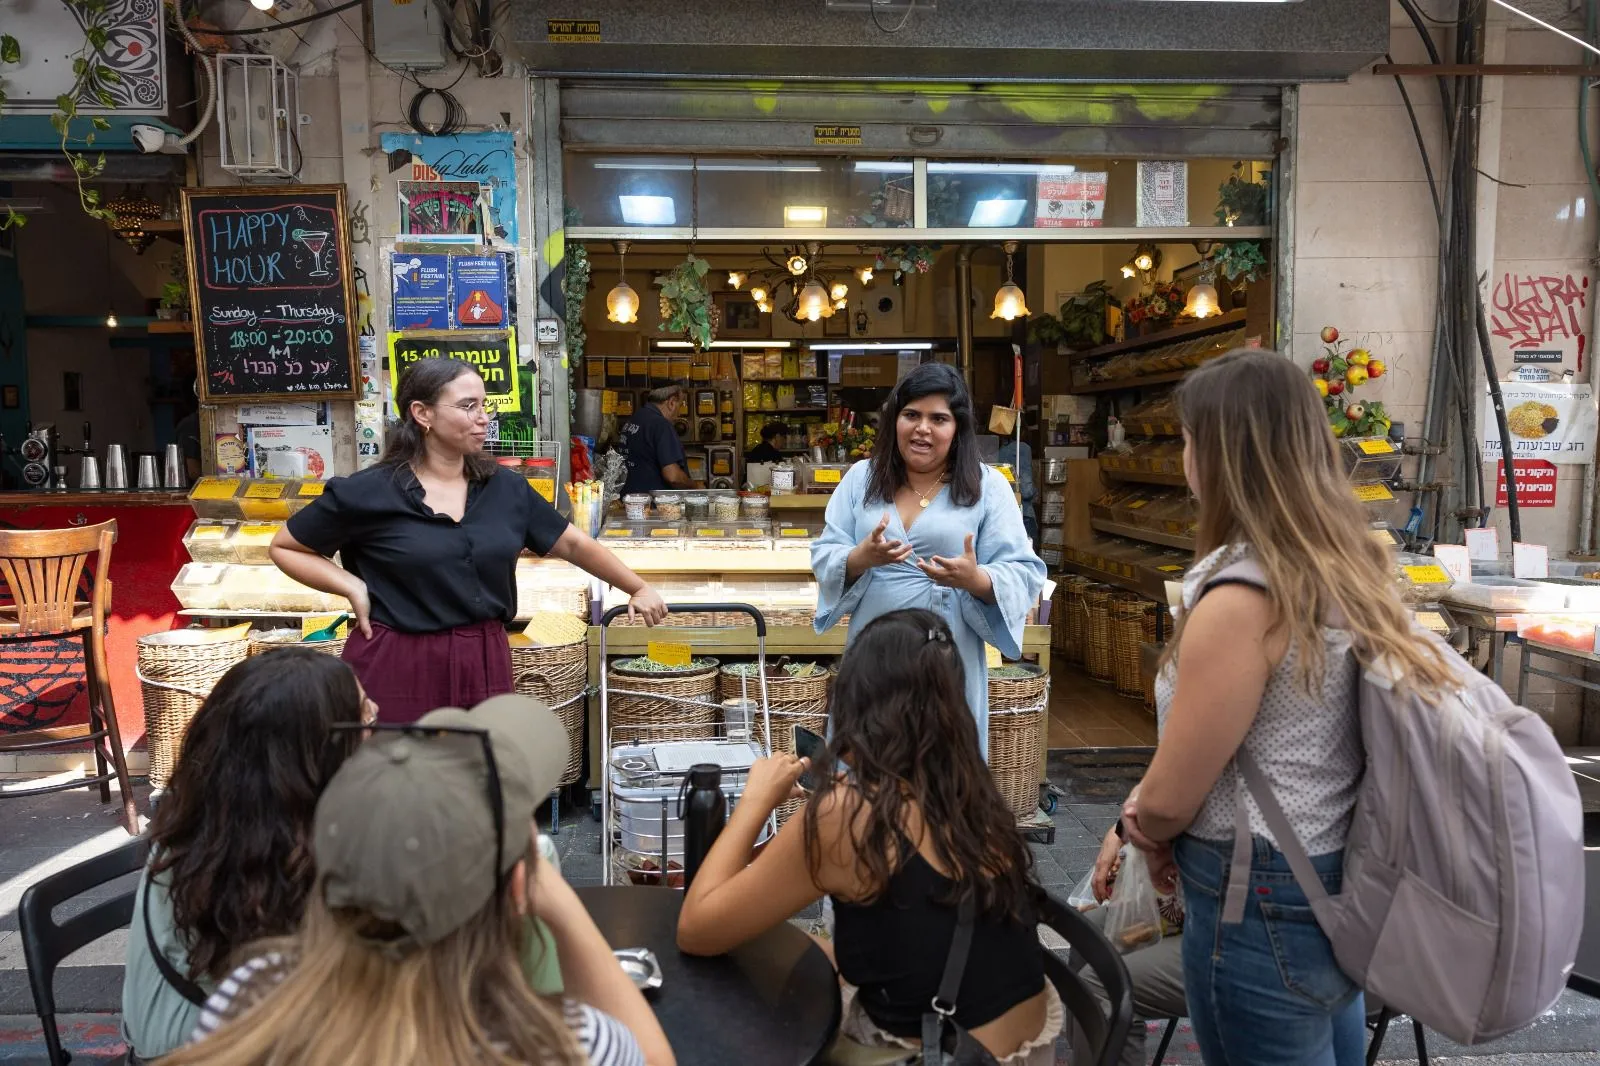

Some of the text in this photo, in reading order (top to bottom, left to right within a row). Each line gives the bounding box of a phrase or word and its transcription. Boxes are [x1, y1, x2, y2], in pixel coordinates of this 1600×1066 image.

[210, 213, 290, 253] HAPPY
[213, 252, 286, 284] HOUR
[212, 306, 258, 326] Sunday
[276, 304, 338, 325] Thursday
[230, 330, 267, 348] 18:00
[284, 329, 334, 345] 20:00
[268, 345, 291, 359] 1+1
[285, 360, 303, 375] כל
[311, 360, 330, 374] על
[1485, 440, 1585, 451] חג שבועות מח
[1526, 483, 1553, 492] מהיום
